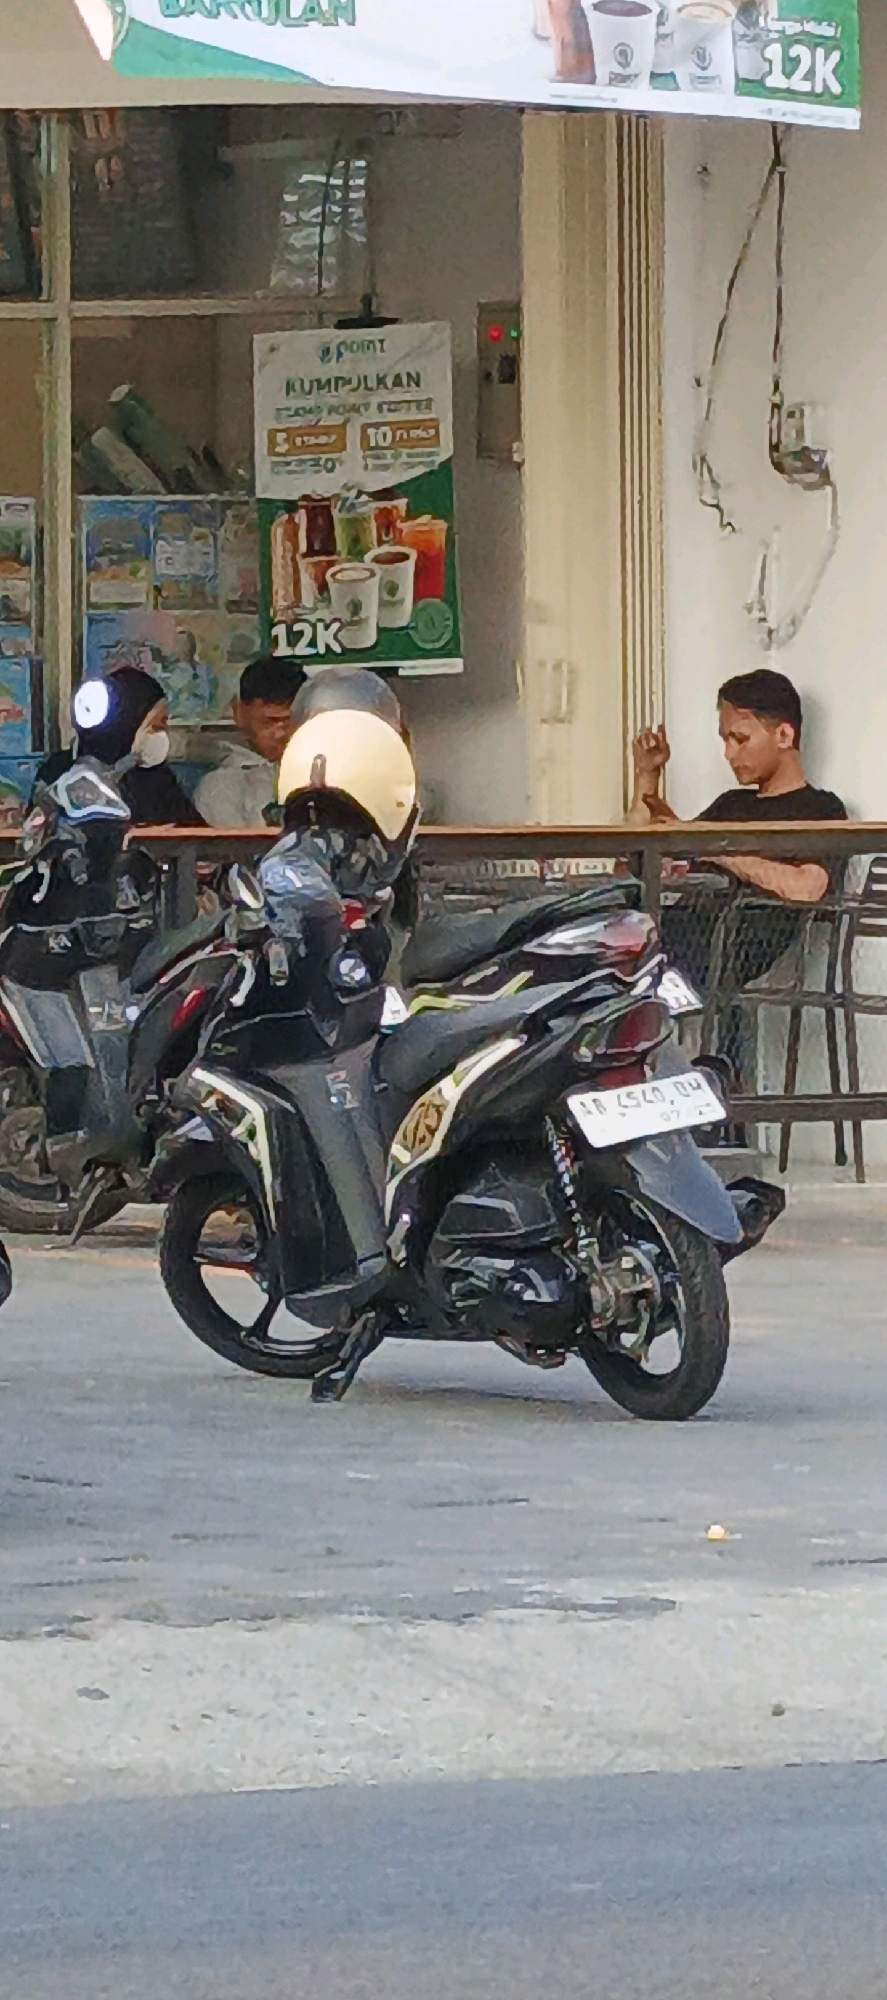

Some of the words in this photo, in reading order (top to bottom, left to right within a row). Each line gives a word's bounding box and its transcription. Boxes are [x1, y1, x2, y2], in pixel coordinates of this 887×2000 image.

[763, 42, 842, 96] 12K
[285, 371, 422, 397] KUMPULKAN
[271, 622, 342, 656] 12K
